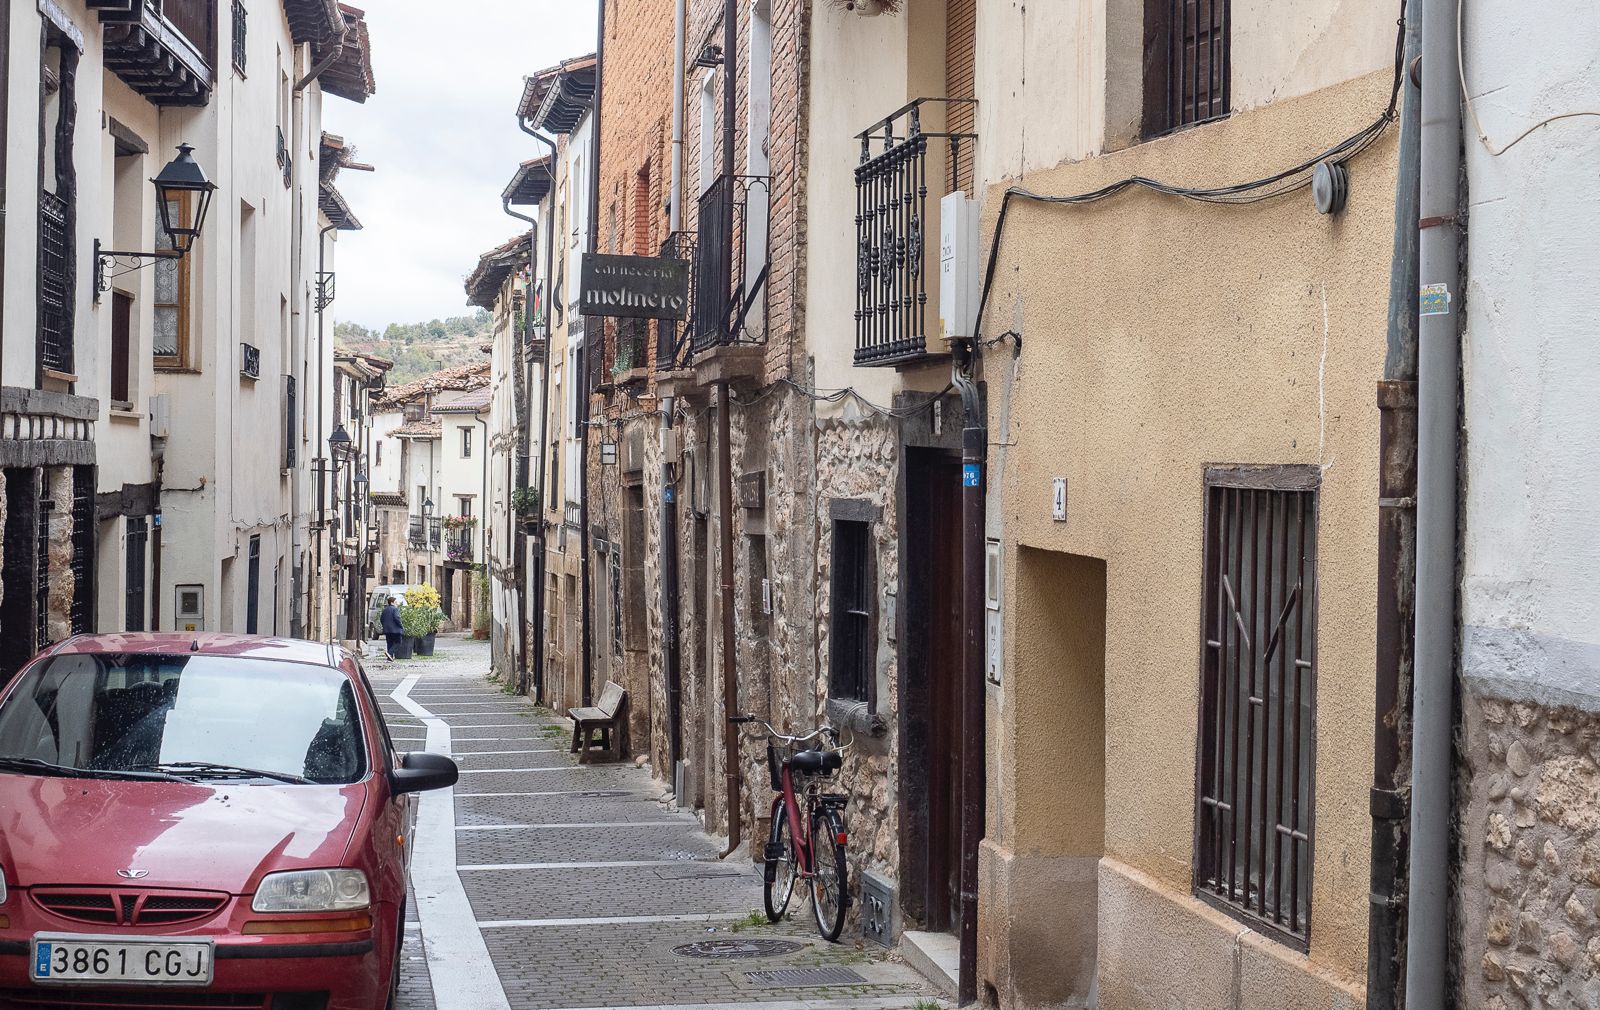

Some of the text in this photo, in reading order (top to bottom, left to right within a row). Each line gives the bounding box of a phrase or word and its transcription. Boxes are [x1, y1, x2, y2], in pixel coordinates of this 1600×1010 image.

[586, 287, 683, 309] molinero
[1056, 487, 1062, 510] 4
[40, 963, 47, 972] E
[53, 947, 202, 976] 3861 CGJ
